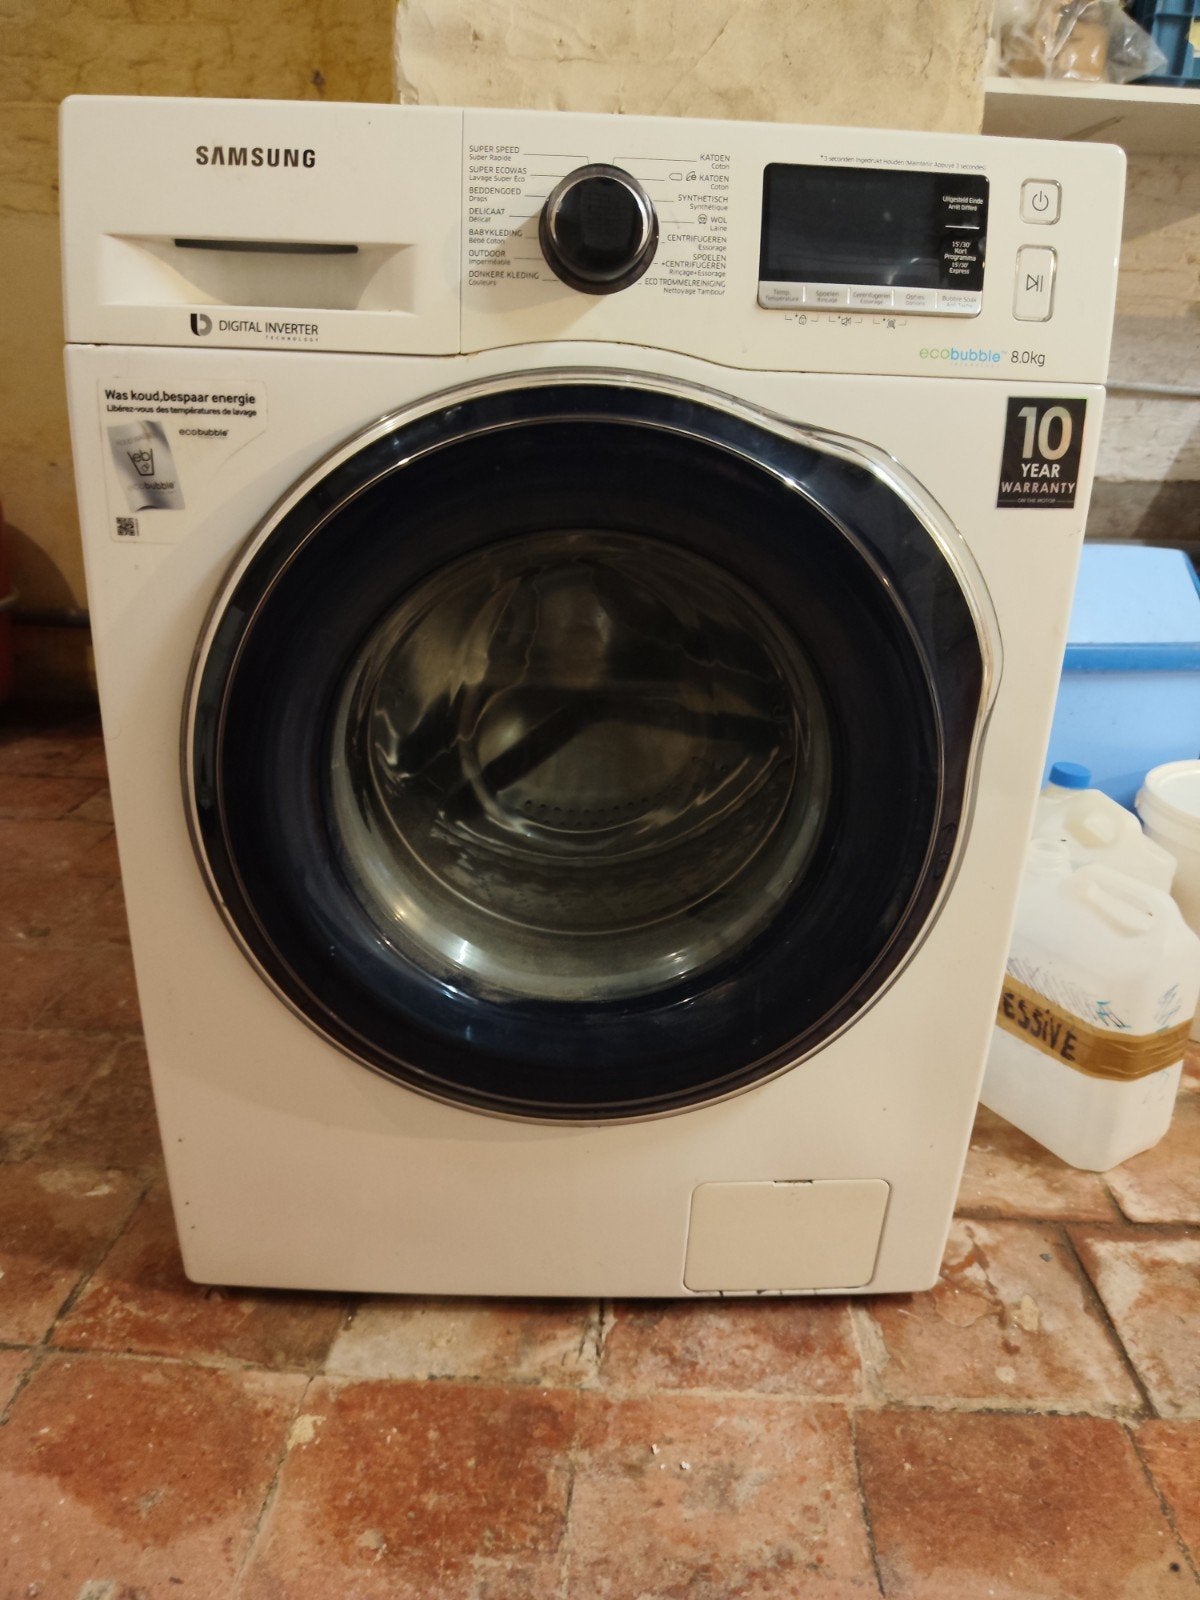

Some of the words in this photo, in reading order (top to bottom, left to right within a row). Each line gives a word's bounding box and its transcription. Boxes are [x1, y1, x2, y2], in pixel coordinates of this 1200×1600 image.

[469, 145, 494, 153] SUPER
[496, 146, 520, 154] SPEED
[195, 145, 316, 169] SAMSUNG
[700, 154, 731, 162] KATOEN
[469, 165, 494, 174] SUPER
[495, 166, 527, 175] ECOWAS
[711, 162, 730, 170] Coton
[699, 174, 730, 183] KATOEN
[469, 186, 522, 196] BEDDENGOED
[710, 183, 729, 191] Coton
[678, 193, 729, 203] SYNTHETISCH
[469, 207, 505, 216] DELICAAT
[710, 216, 728, 224] WOL
[469, 228, 523, 238] BABYKLEDING
[666, 234, 728, 244] CENTRIFUGEREN
[698, 244, 728, 252] Essorage
[468, 249, 506, 258] OUTDOOR
[692, 253, 727, 262] SPOELEN
[468, 270, 505, 279] DONKERE
[506, 271, 540, 280] KLEDING
[644, 278, 659, 286] ECO
[219, 320, 263, 333] DIGITAL
[265, 322, 319, 336] INVERTER
[919, 347, 1001, 362] ecobubble
[1010, 350, 1046, 367] 8.0kg
[105, 389, 129, 401] Was
[211, 393, 256, 407] energie
[155, 405, 170, 414] des
[232, 408, 257, 418] lavage
[1017, 406, 1073, 461] 10
[1021, 463, 1061, 478] YEAR
[1001, 481, 1076, 494] WARRANTY
